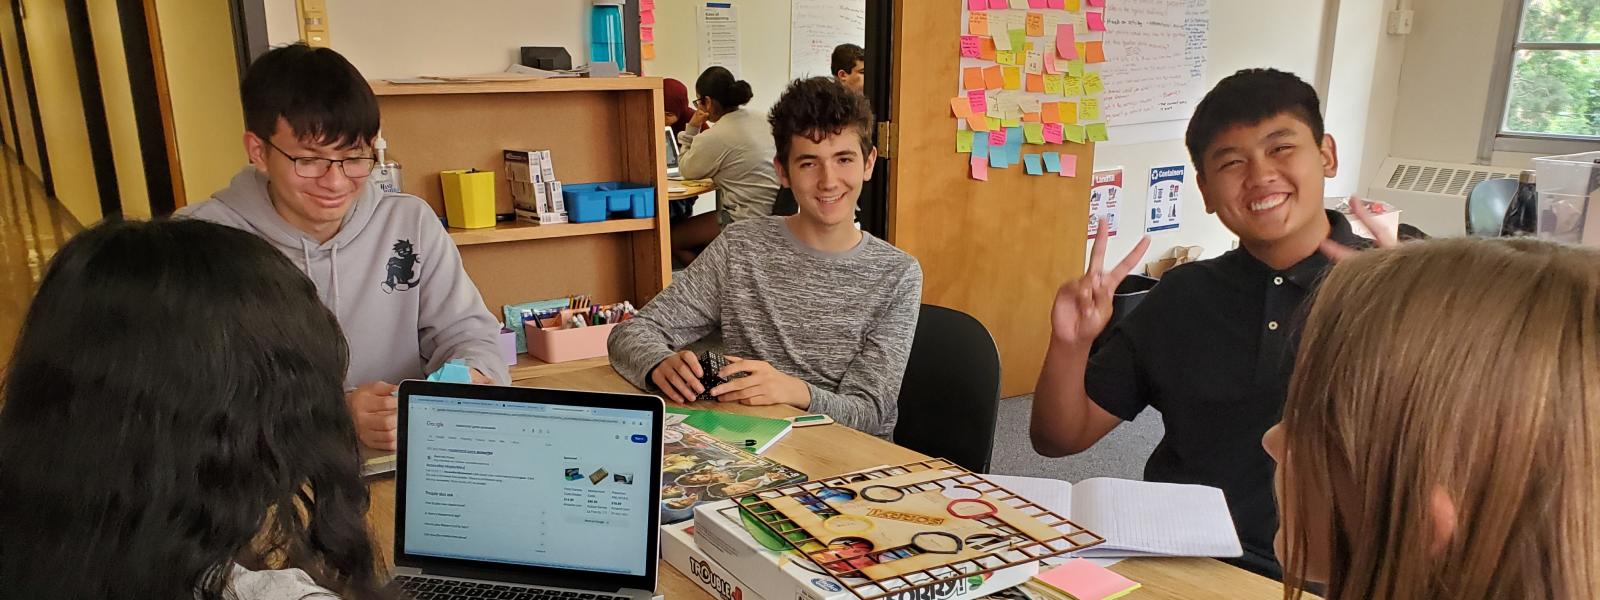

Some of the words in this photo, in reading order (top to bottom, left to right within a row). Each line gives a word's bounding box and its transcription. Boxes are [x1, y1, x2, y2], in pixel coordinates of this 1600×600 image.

[1158, 168, 1184, 178] Containers
[426, 420, 444, 429] Google
[689, 556, 732, 600] TROUBLE
